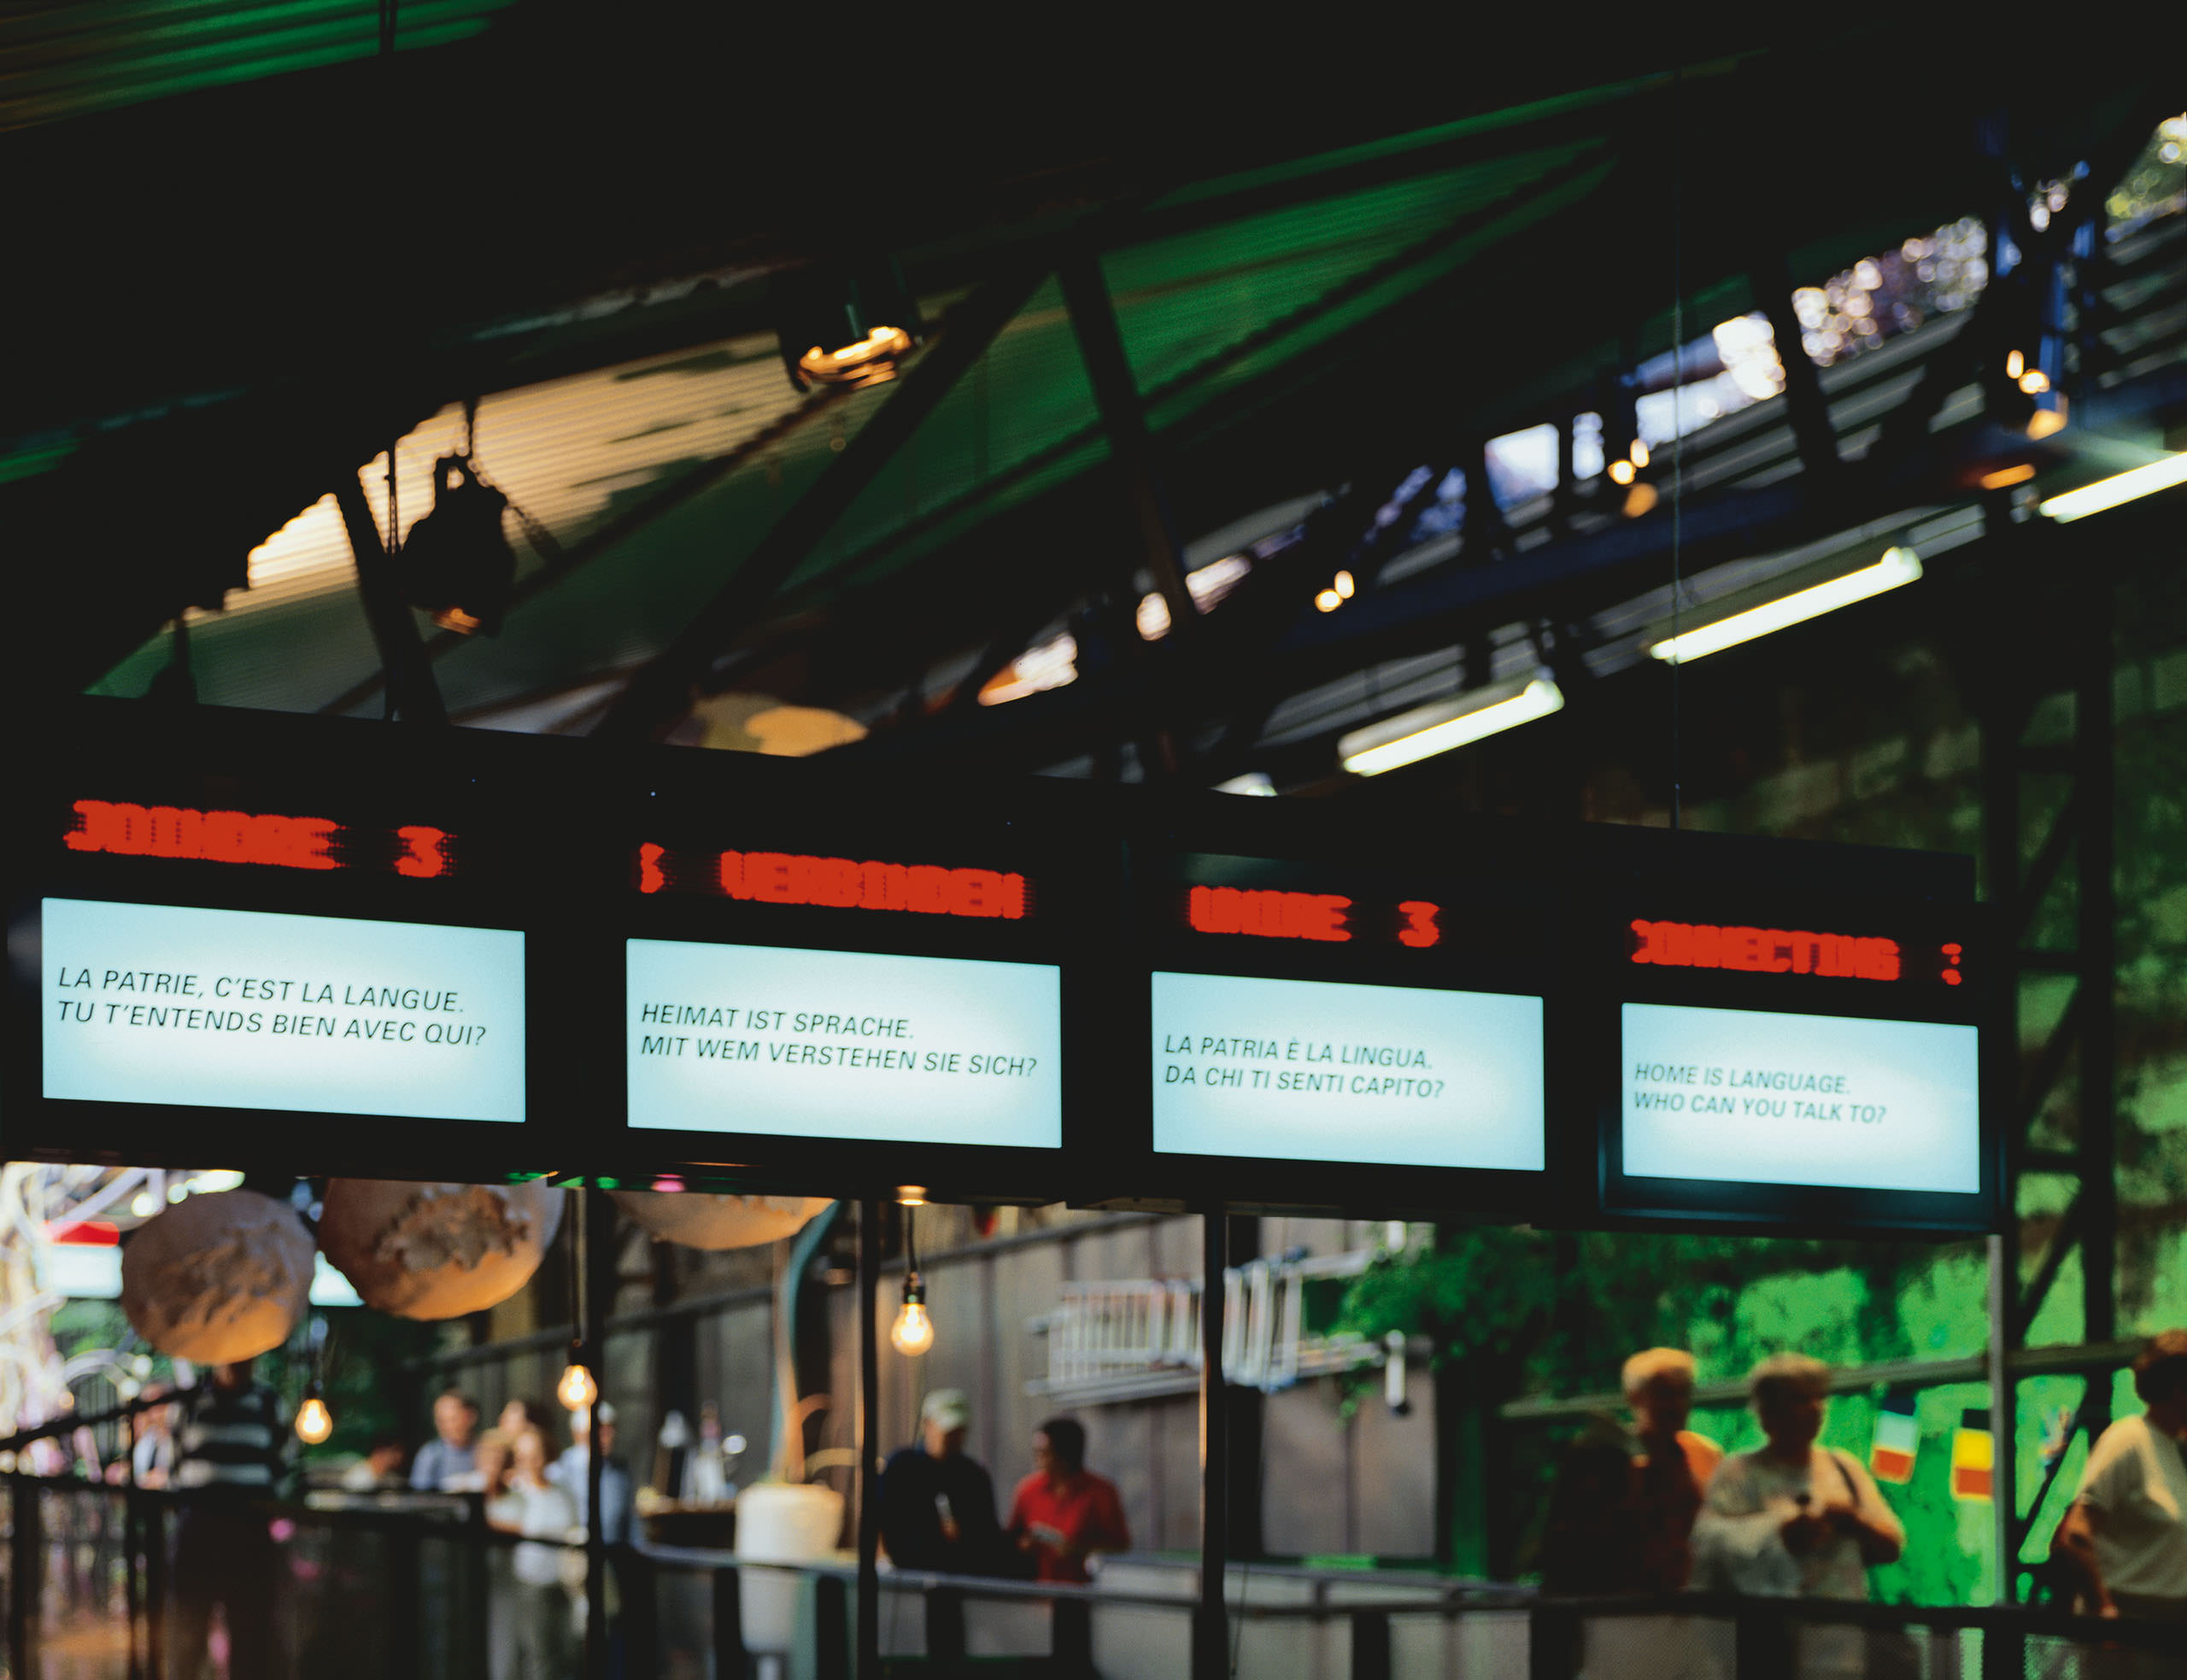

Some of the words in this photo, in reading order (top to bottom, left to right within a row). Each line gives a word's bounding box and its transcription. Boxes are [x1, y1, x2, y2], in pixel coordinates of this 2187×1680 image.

[1398, 901, 1439, 947] 3
[58, 967, 92, 989] LA
[102, 969, 204, 999] PATRIE,
[214, 976, 296, 1001] C'EST
[301, 982, 334, 1004] LA
[343, 984, 463, 1012] LANGUE.
[58, 1000, 95, 1023] TU
[104, 1003, 263, 1033] T'ENTENDS
[271, 1013, 337, 1038] BIEN
[343, 1018, 417, 1042] AVEC
[424, 1023, 487, 1045] QUI?
[641, 1003, 740, 1027] HEIMAT
[746, 1010, 788, 1031] IST
[793, 1012, 913, 1039] SPRACHE.
[641, 1034, 690, 1057] MIT
[697, 1038, 760, 1062] WEM
[769, 1042, 918, 1070] VERSTEHEN
[923, 1051, 962, 1073] SIE
[968, 1054, 1037, 1076] SICH?
[1164, 1034, 1192, 1055] LA
[1200, 1036, 1279, 1060] PATRIA
[1285, 1036, 1300, 1062] È
[1305, 1042, 1334, 1063] LA
[1340, 1044, 1433, 1069] LINGUA.
[1164, 1064, 1196, 1086] DA
[1204, 1066, 1244, 1088] CHI
[1251, 1068, 1271, 1090] TI
[1275, 1070, 1345, 1093] SENTI
[1350, 1074, 1445, 1098] CAPITO?
[1635, 1062, 1698, 1085] HOME
[1703, 1067, 1724, 1086] IS
[1728, 1068, 1850, 1094] LANGUAGE.
[1634, 1092, 1686, 1112] WHO
[1690, 1094, 1736, 1115] CAN
[1743, 1098, 1786, 1118] YOU
[1793, 1100, 1843, 1121] TALK
[1849, 1103, 1887, 1124] TO?
